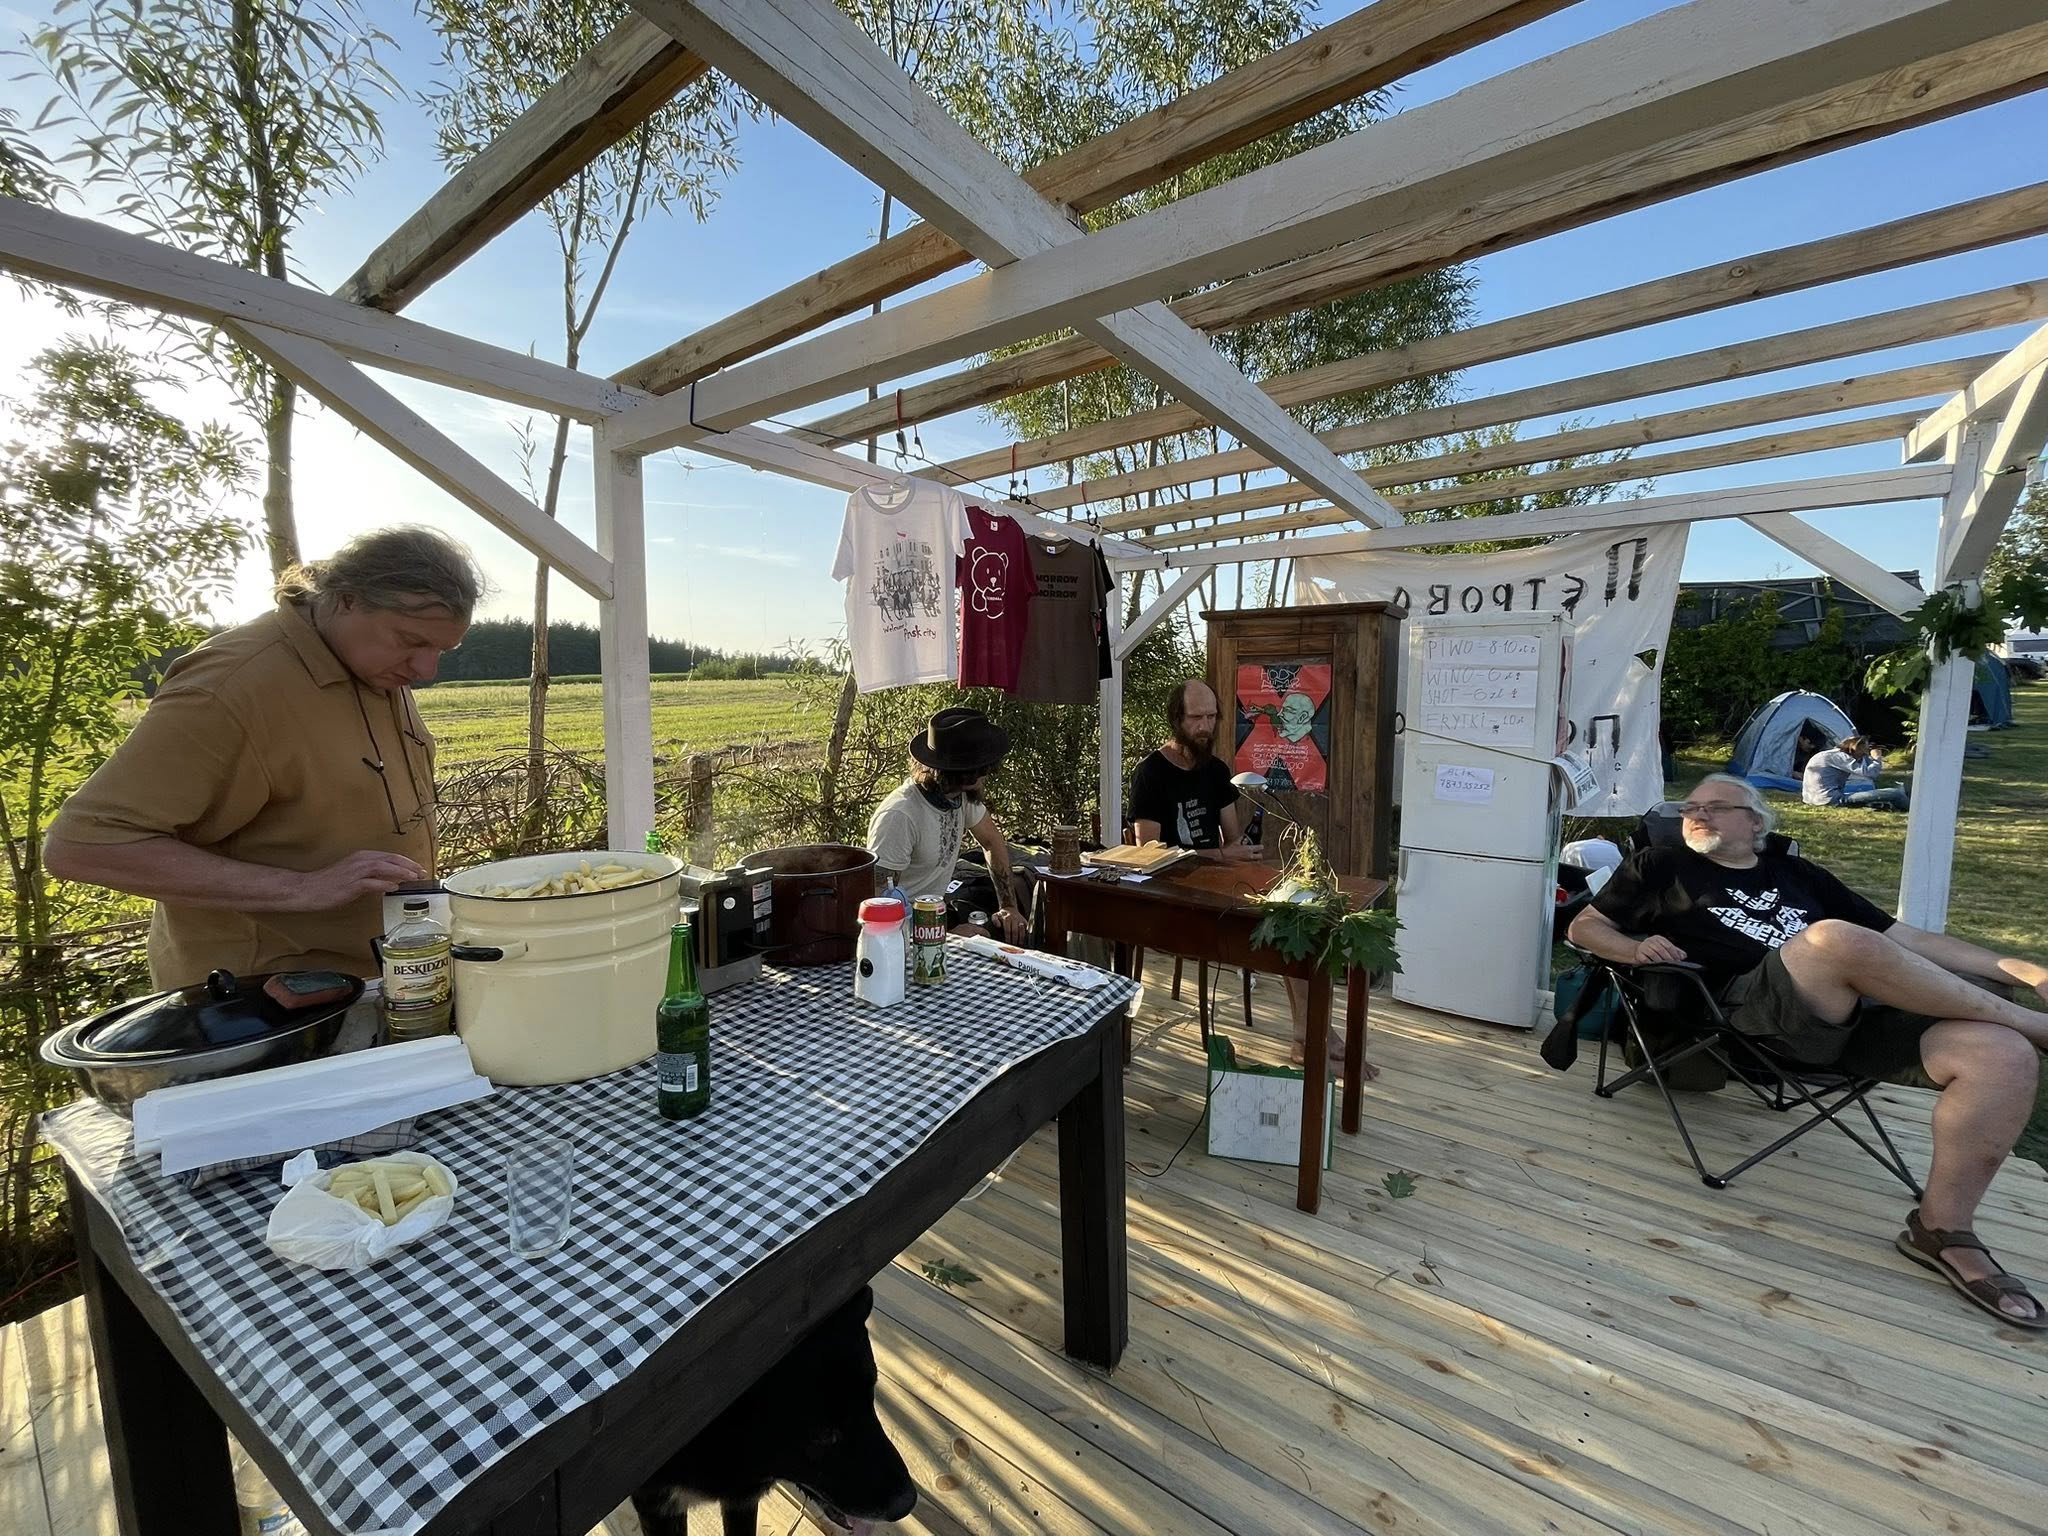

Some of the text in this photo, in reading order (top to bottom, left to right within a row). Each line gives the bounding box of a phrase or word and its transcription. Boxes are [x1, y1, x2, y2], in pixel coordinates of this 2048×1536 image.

[1036, 574, 1079, 585] MORROW
[1427, 667, 1475, 686] WINO
[1425, 688, 1461, 705] SHOT
[394, 957, 449, 975] BESKIDZKI
